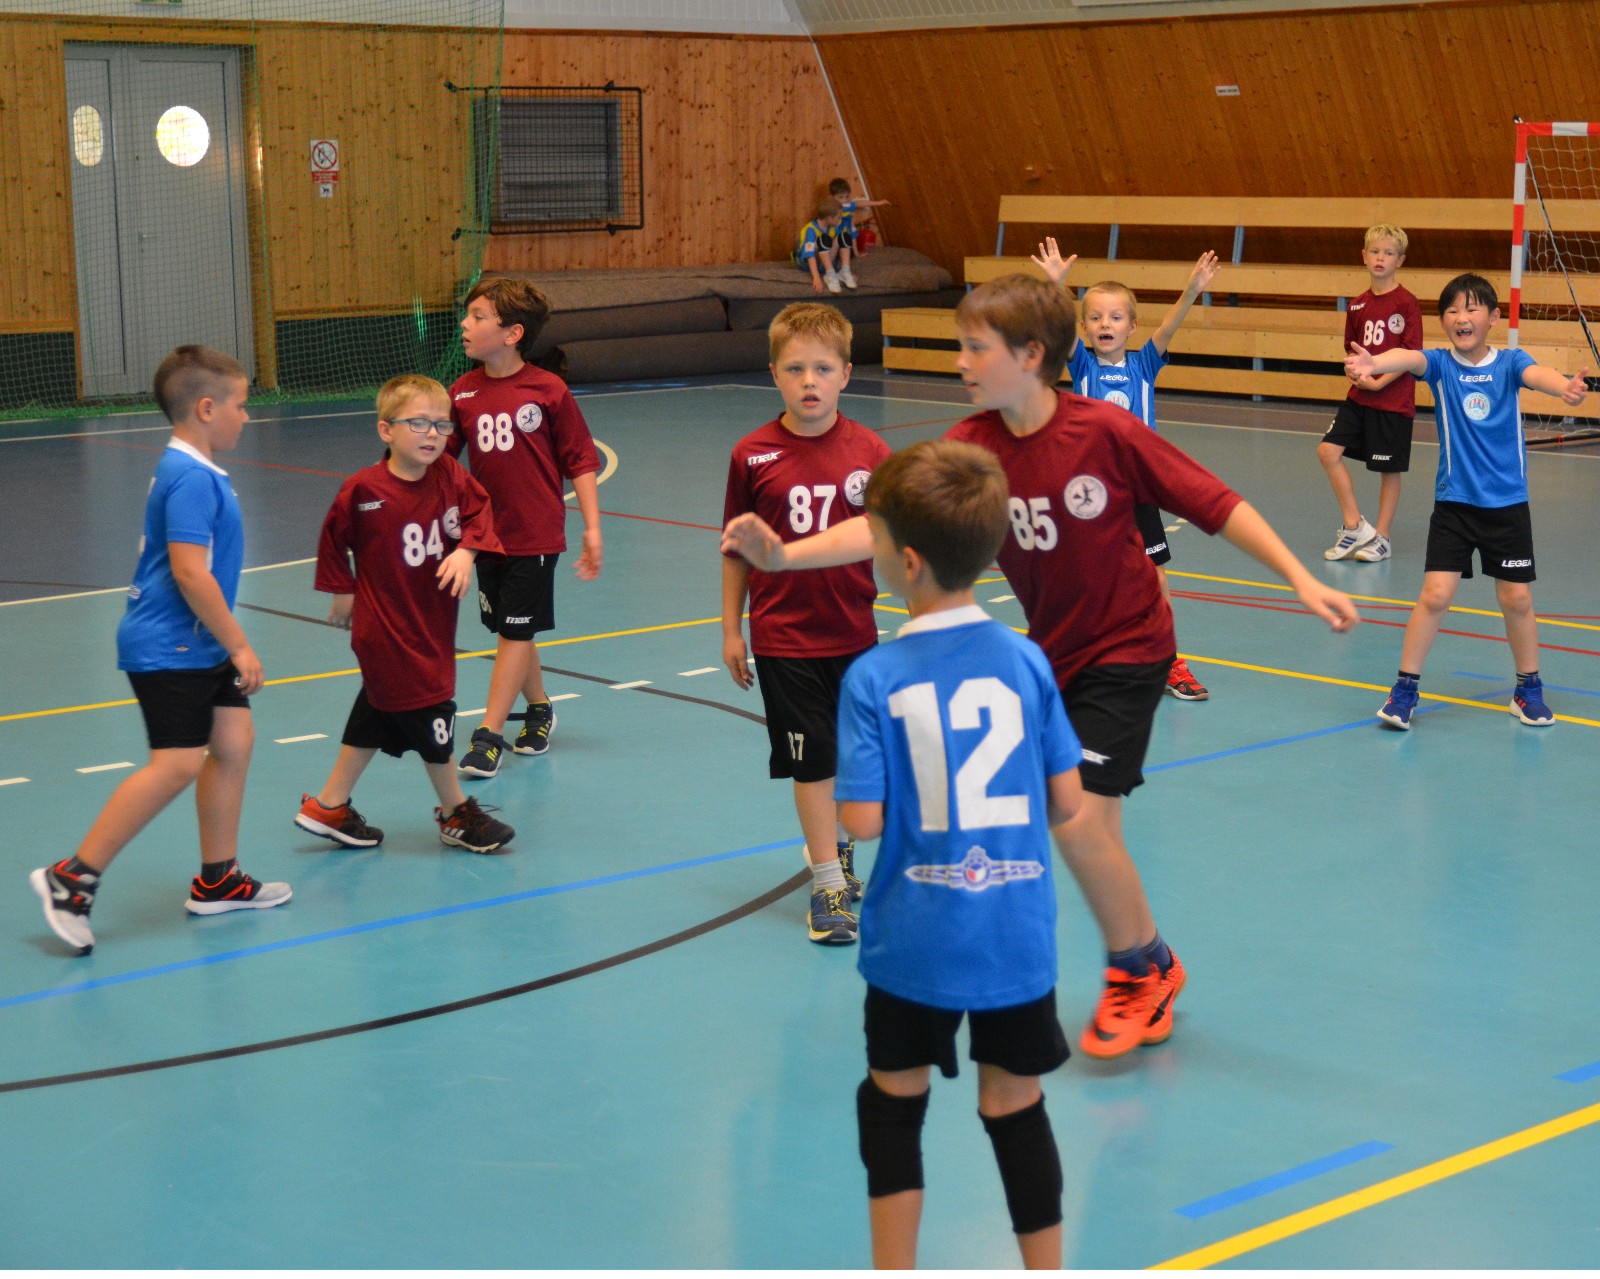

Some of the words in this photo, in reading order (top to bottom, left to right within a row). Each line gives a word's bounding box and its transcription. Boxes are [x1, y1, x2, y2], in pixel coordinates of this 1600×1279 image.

[1363, 320, 1385, 346] 86
[1459, 374, 1493, 383] LEGEA
[478, 413, 514, 452] 88
[748, 451, 783, 466] max
[789, 485, 836, 534] 87
[1008, 496, 1058, 551] 85
[403, 519, 444, 567] 84
[1502, 559, 1532, 567] LEGEA
[505, 616, 533, 624] max
[887, 677, 1030, 832] 12
